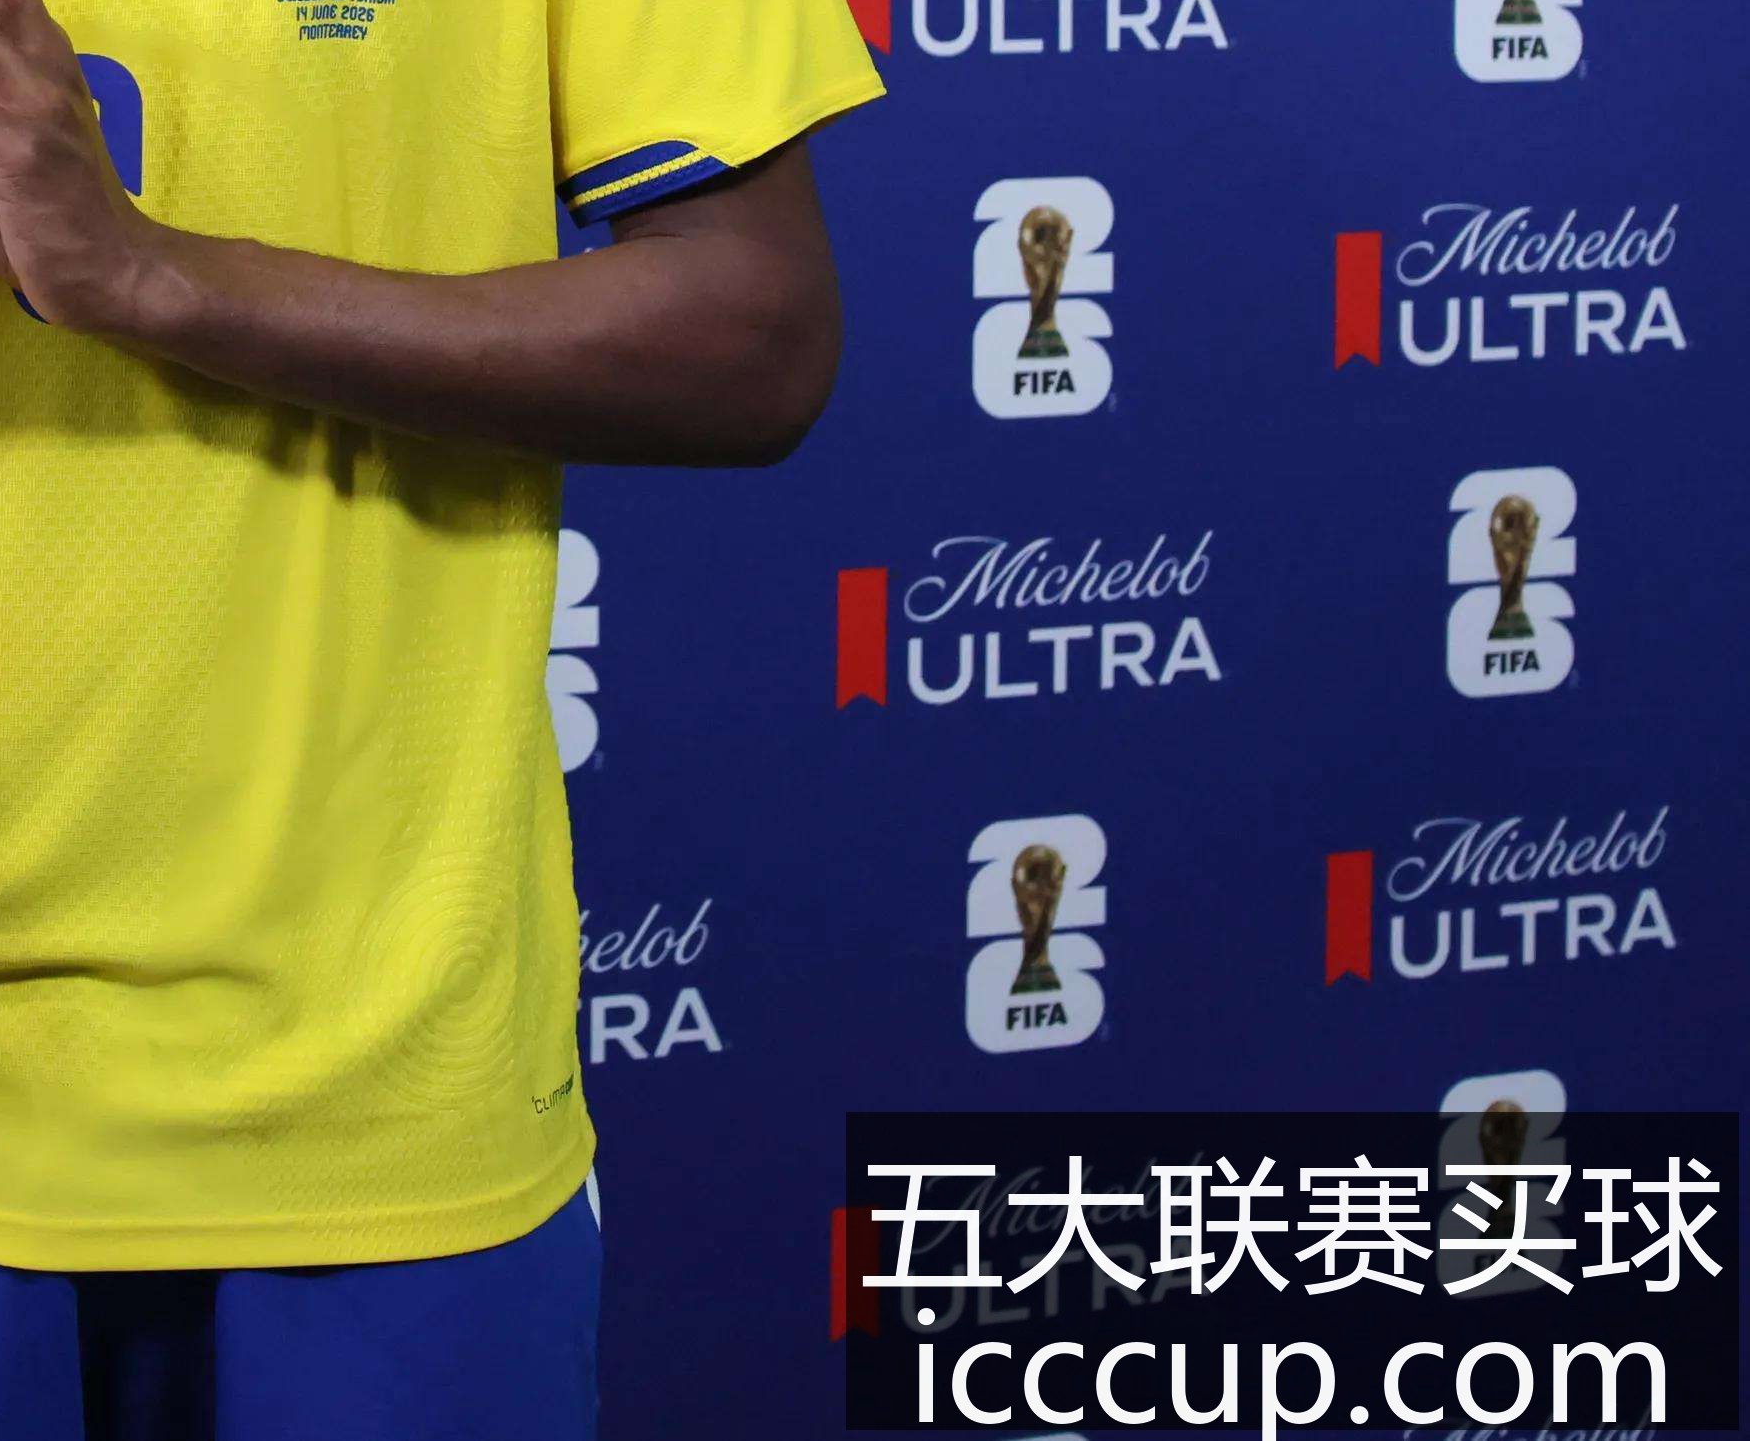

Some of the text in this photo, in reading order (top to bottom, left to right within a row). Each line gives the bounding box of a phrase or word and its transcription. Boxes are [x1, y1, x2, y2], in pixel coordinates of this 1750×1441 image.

[296, 5, 375, 22] 14 JUNE 2026
[299, 23, 368, 40] MONTERREY
[1492, 37, 1548, 59] FIFA
[1397, 204, 1678, 285] Michelob
[1400, 288, 1686, 365] ULTRA
[1014, 369, 1075, 396] FIFA
[905, 531, 1212, 621] Michelob
[908, 618, 1221, 704] ULTRA
[1484, 650, 1540, 675] FIFA
[1388, 806, 1668, 901] Michelob
[1391, 889, 1676, 978] ULTRA
[1006, 1002, 1068, 1031] FIFA
